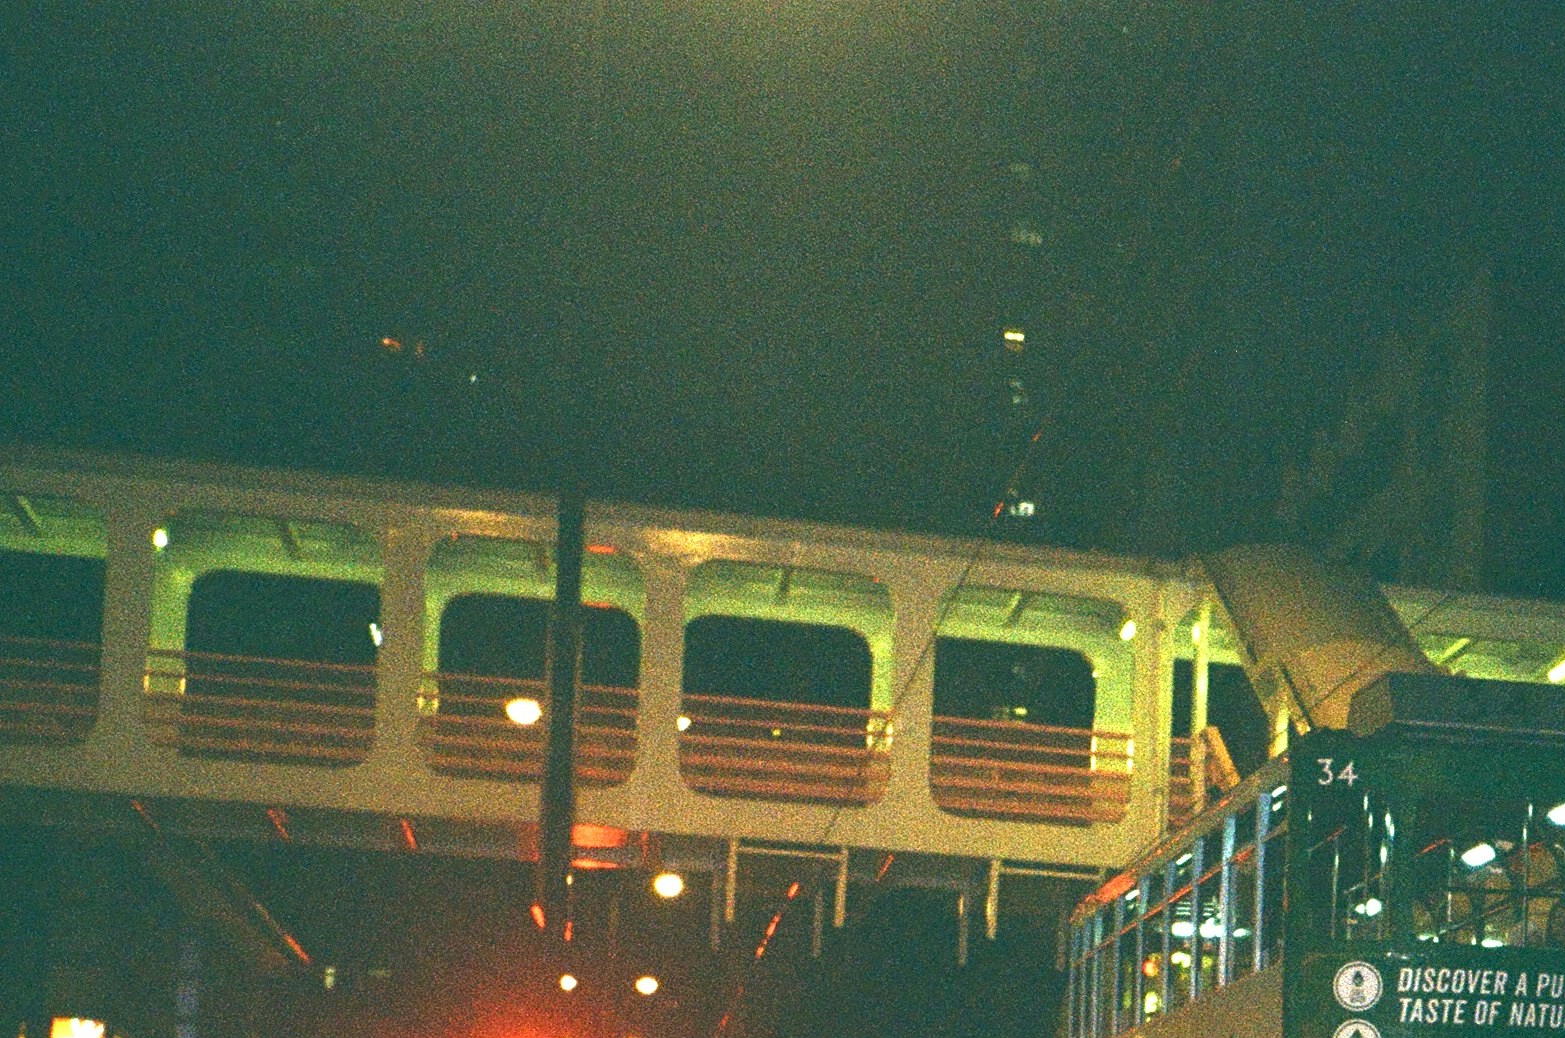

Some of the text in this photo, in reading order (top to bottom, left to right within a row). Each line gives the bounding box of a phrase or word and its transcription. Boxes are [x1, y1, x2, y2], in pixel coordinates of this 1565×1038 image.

[1316, 757, 1359, 788] 34
[1398, 967, 1508, 995] DISCOVER
[1514, 972, 1528, 998] A
[1399, 998, 1467, 1025] TASTE
[1474, 999, 1501, 1025] OF
